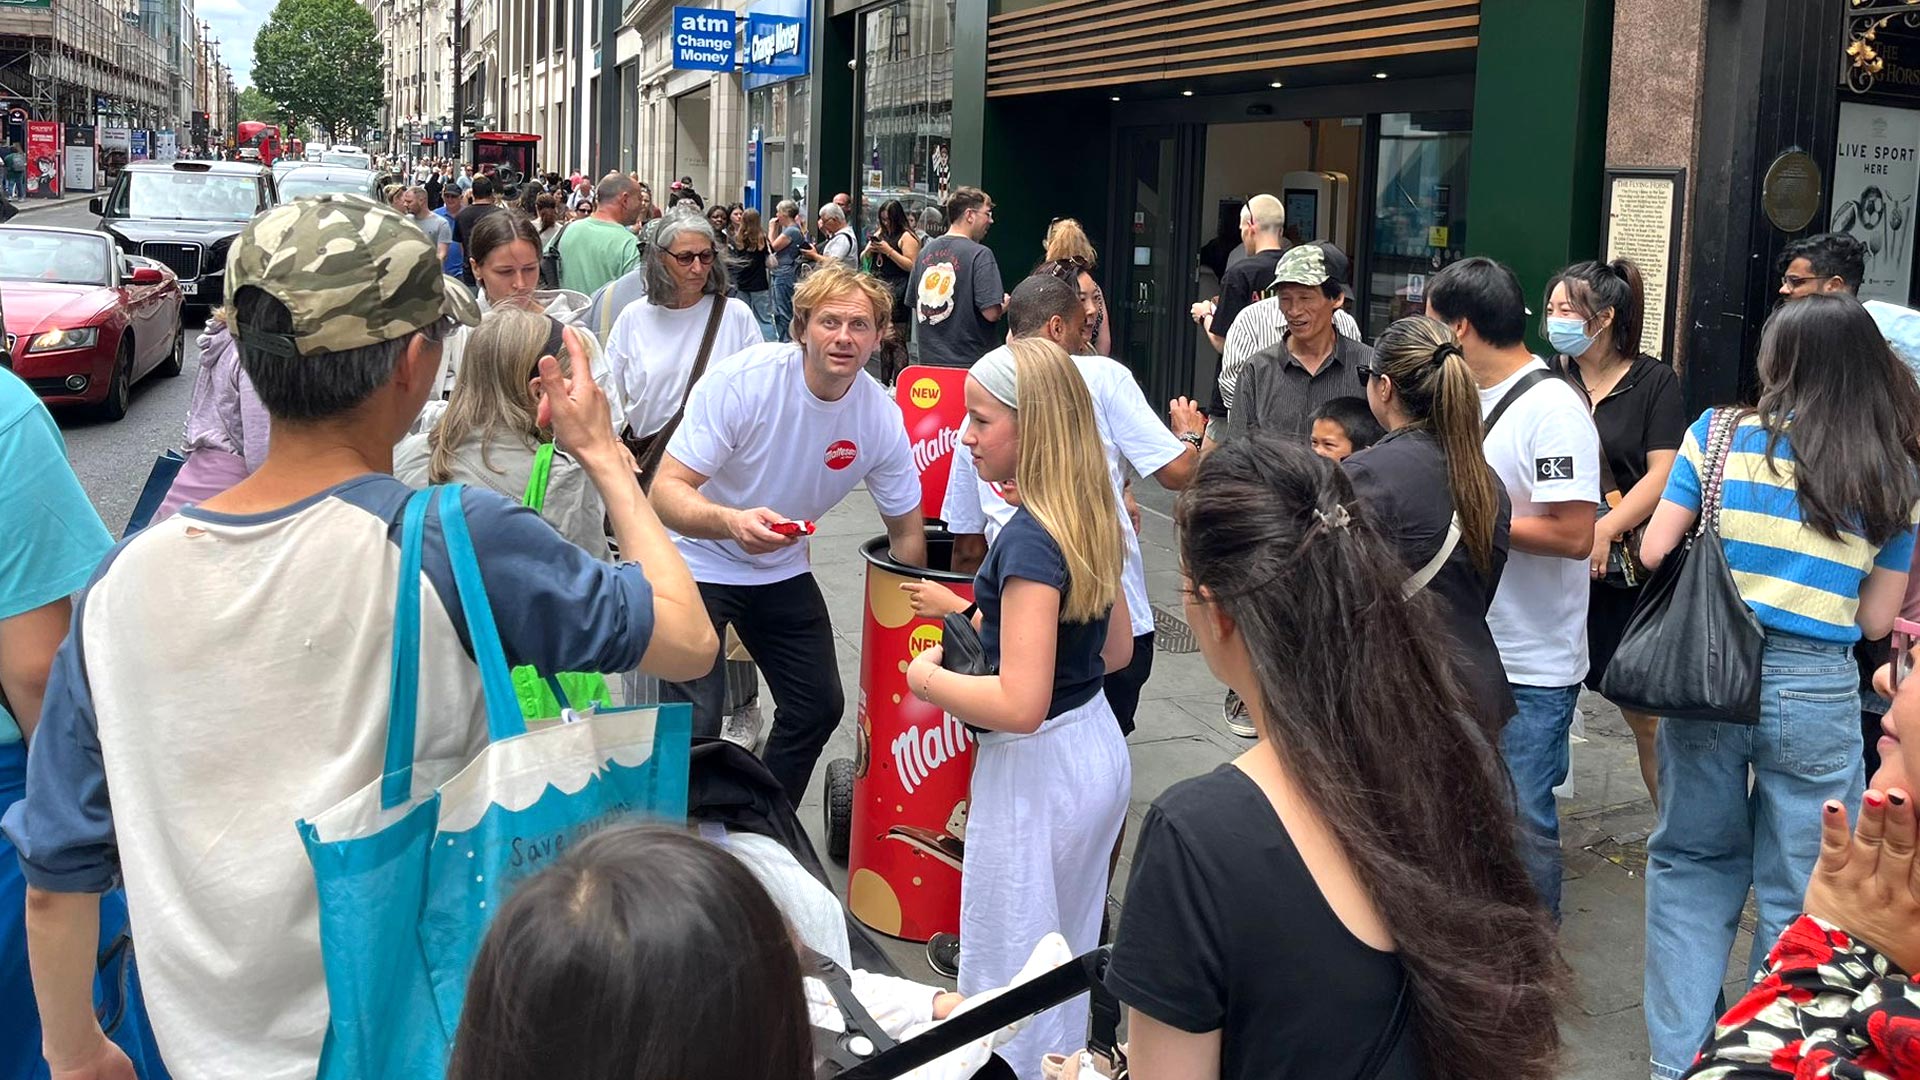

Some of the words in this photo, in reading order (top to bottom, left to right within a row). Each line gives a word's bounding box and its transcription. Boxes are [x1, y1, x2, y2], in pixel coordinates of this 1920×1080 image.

[681, 14, 729, 33] atm
[677, 34, 732, 51] Change
[751, 34, 775, 65] Change
[775, 22, 800, 56] Money
[680, 49, 729, 66] Money
[1838, 143, 1867, 158] LIVE
[1874, 146, 1915, 162] SPORT
[1864, 164, 1889, 175] HERE
[912, 388, 939, 399] NEW
[511, 834, 563, 867] Save
